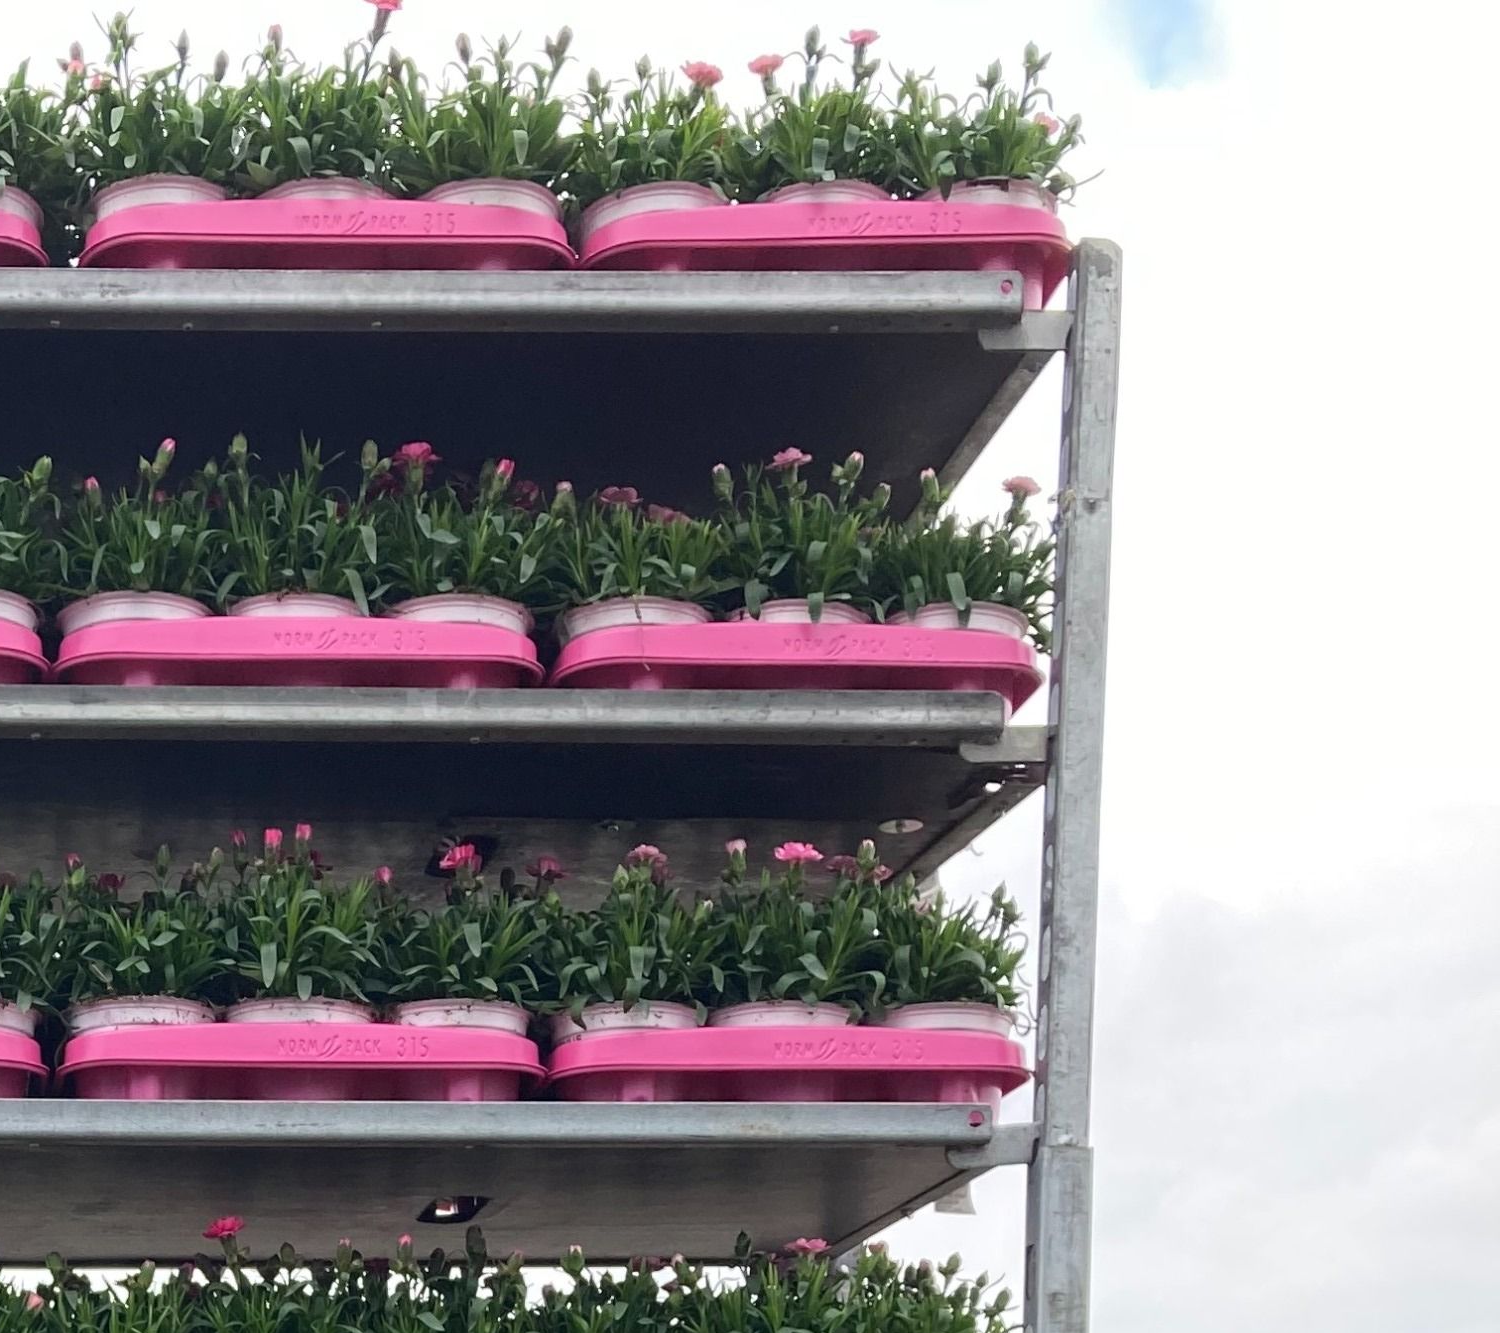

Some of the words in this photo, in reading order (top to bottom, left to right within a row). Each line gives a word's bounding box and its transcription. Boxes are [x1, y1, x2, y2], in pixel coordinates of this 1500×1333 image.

[278, 1038, 318, 1056] NORM
[347, 1038, 381, 1056] PACK
[396, 1036, 429, 1057] 315
[773, 1041, 813, 1058] NORM
[842, 1041, 877, 1058] PACK
[891, 1038, 924, 1060] 315
